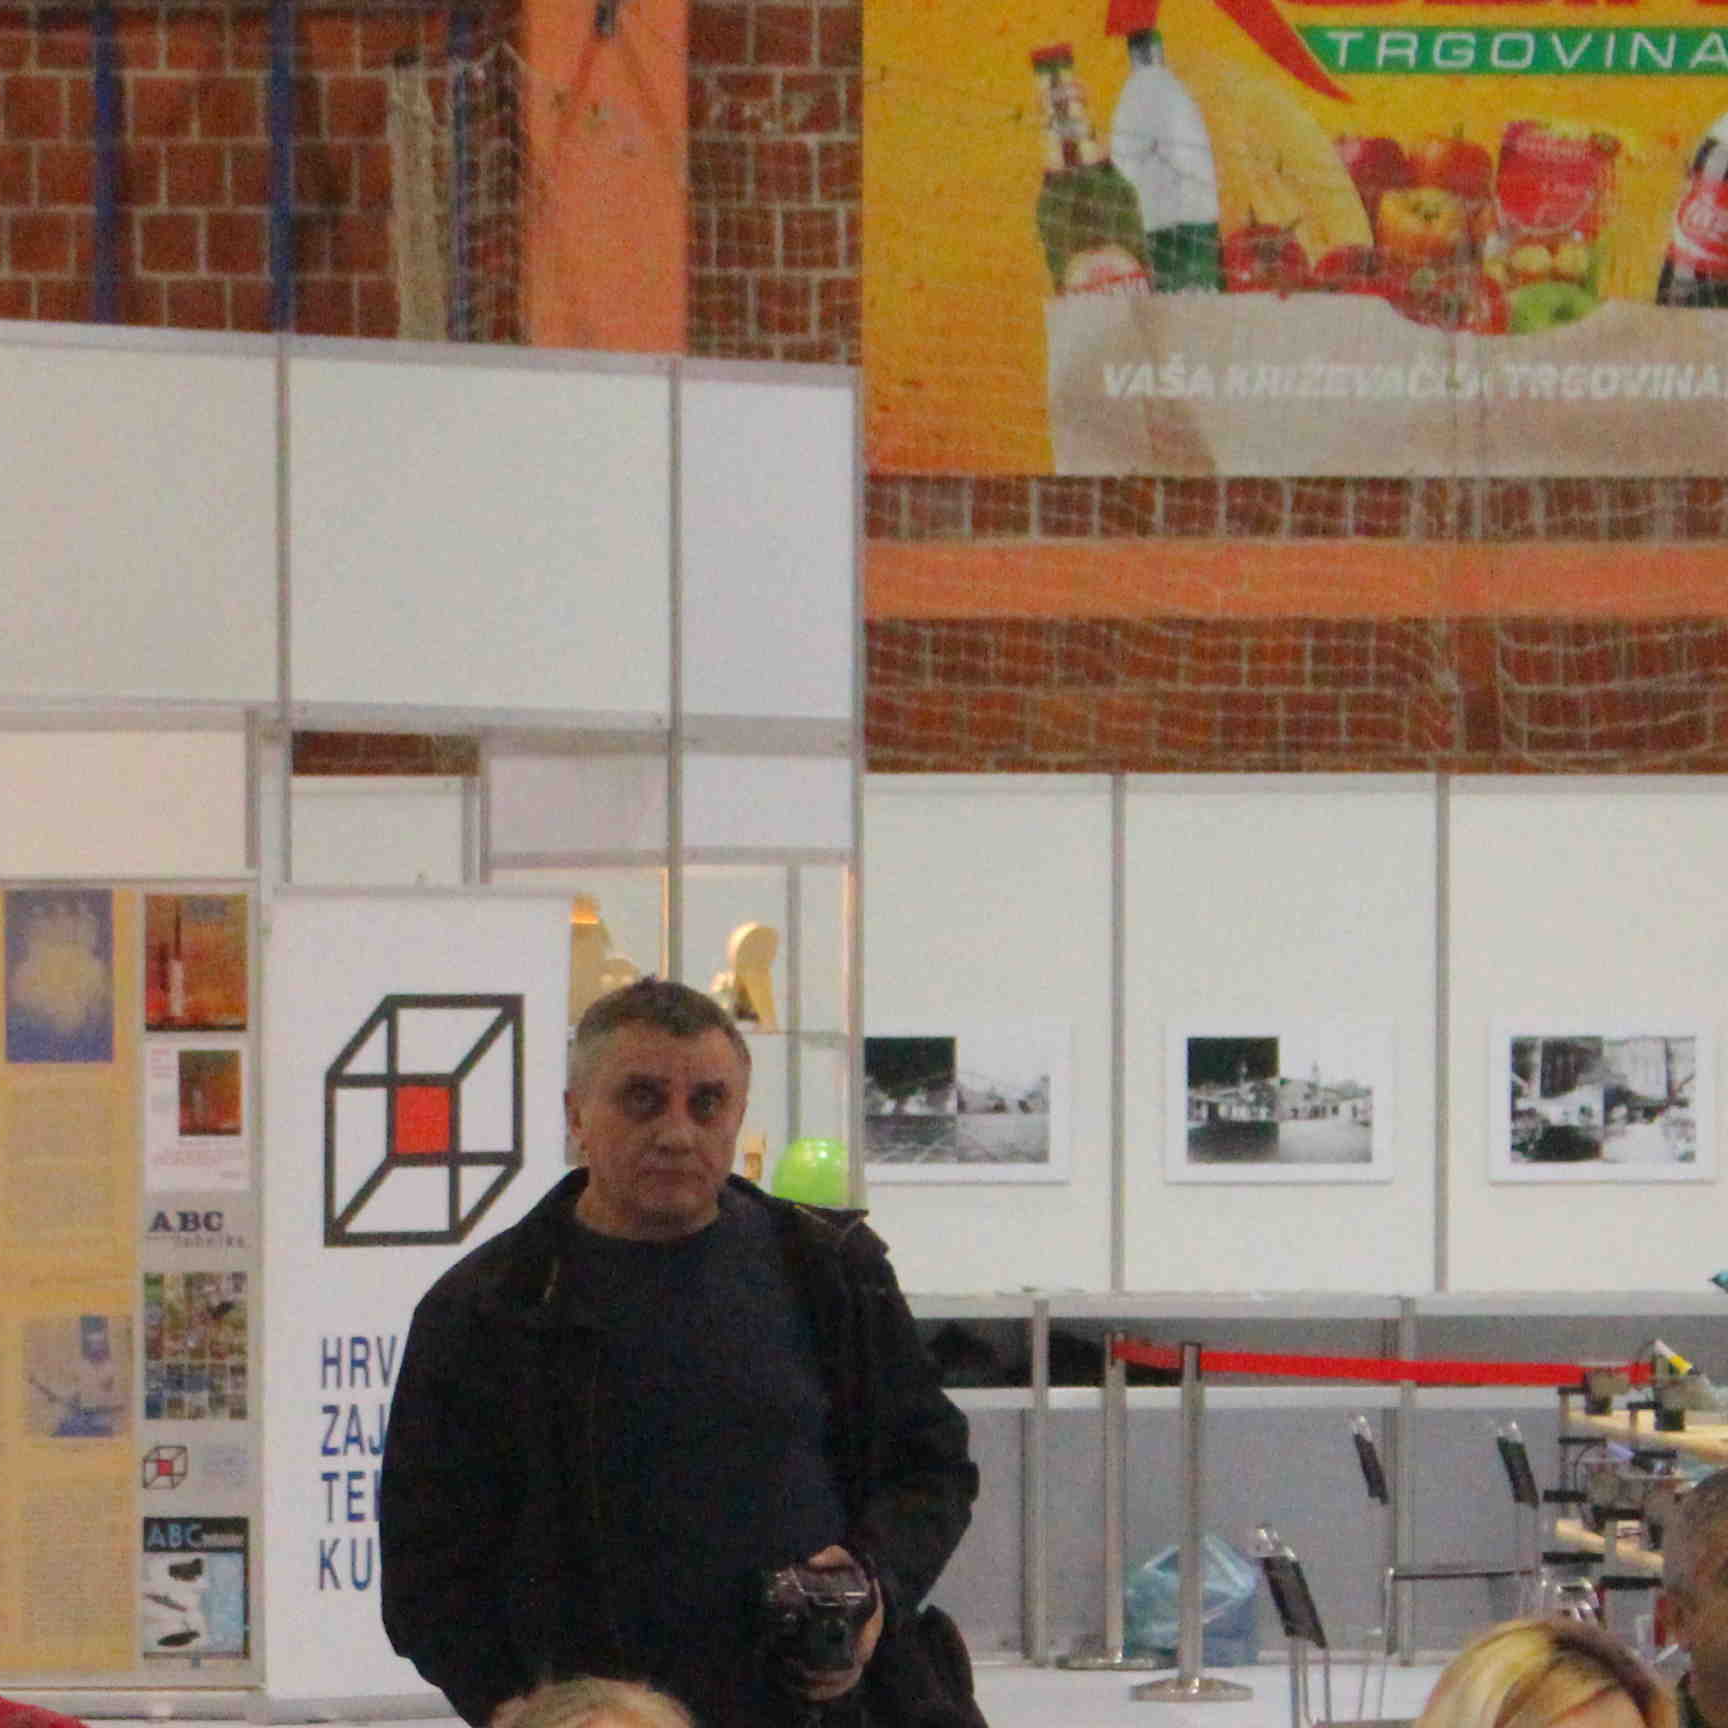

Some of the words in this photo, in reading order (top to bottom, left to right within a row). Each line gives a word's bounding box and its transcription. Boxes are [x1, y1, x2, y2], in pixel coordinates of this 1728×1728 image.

[1103, 353, 1215, 399] VAŠA
[148, 1210, 224, 1233] ABC
[321, 1470, 381, 1524] TE
[147, 1521, 205, 1549] ABC
